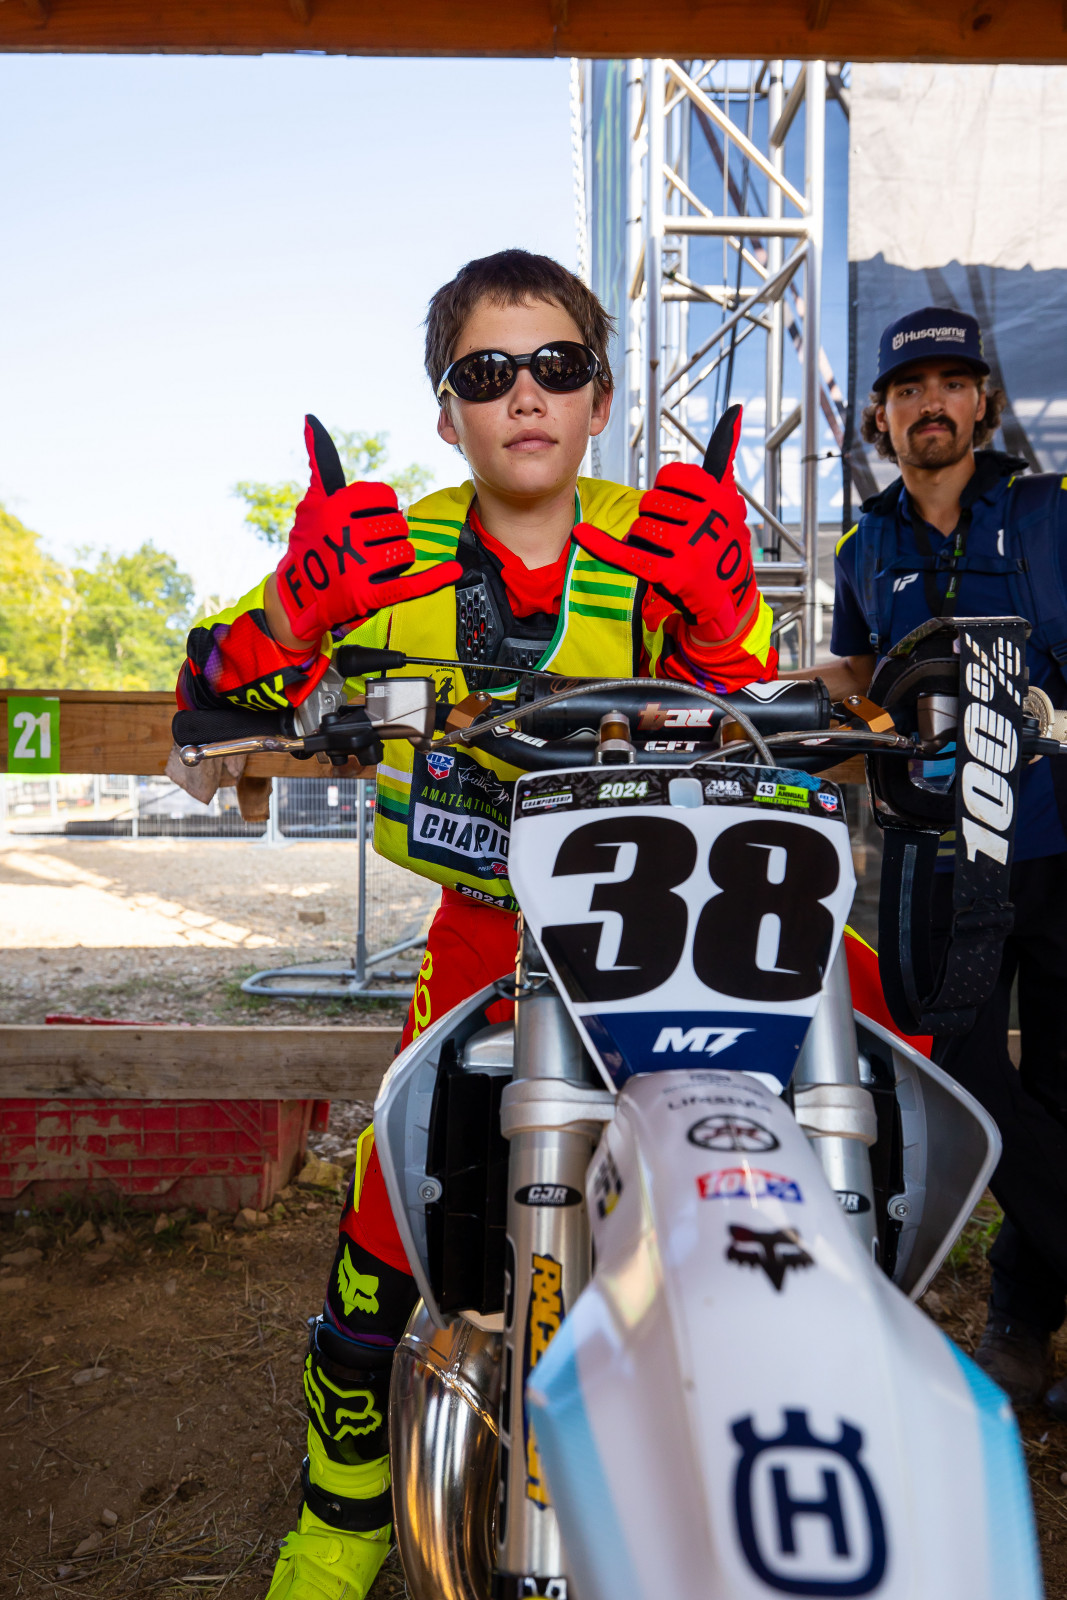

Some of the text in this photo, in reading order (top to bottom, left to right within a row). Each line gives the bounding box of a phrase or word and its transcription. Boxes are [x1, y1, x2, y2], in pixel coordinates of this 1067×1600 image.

[905, 327, 966, 343] Husqvarna
[285, 526, 367, 608] FOX
[688, 509, 753, 607] FOX
[13, 711, 51, 758] 21
[962, 632, 1021, 865] 100%
[599, 781, 648, 799] 2024
[760, 784, 774, 794] 43
[524, 796, 571, 807] CHAMPIONSHIP
[461, 886, 504, 907] 2024
[541, 816, 840, 1002] 38
[528, 1186, 568, 1199] CJR
